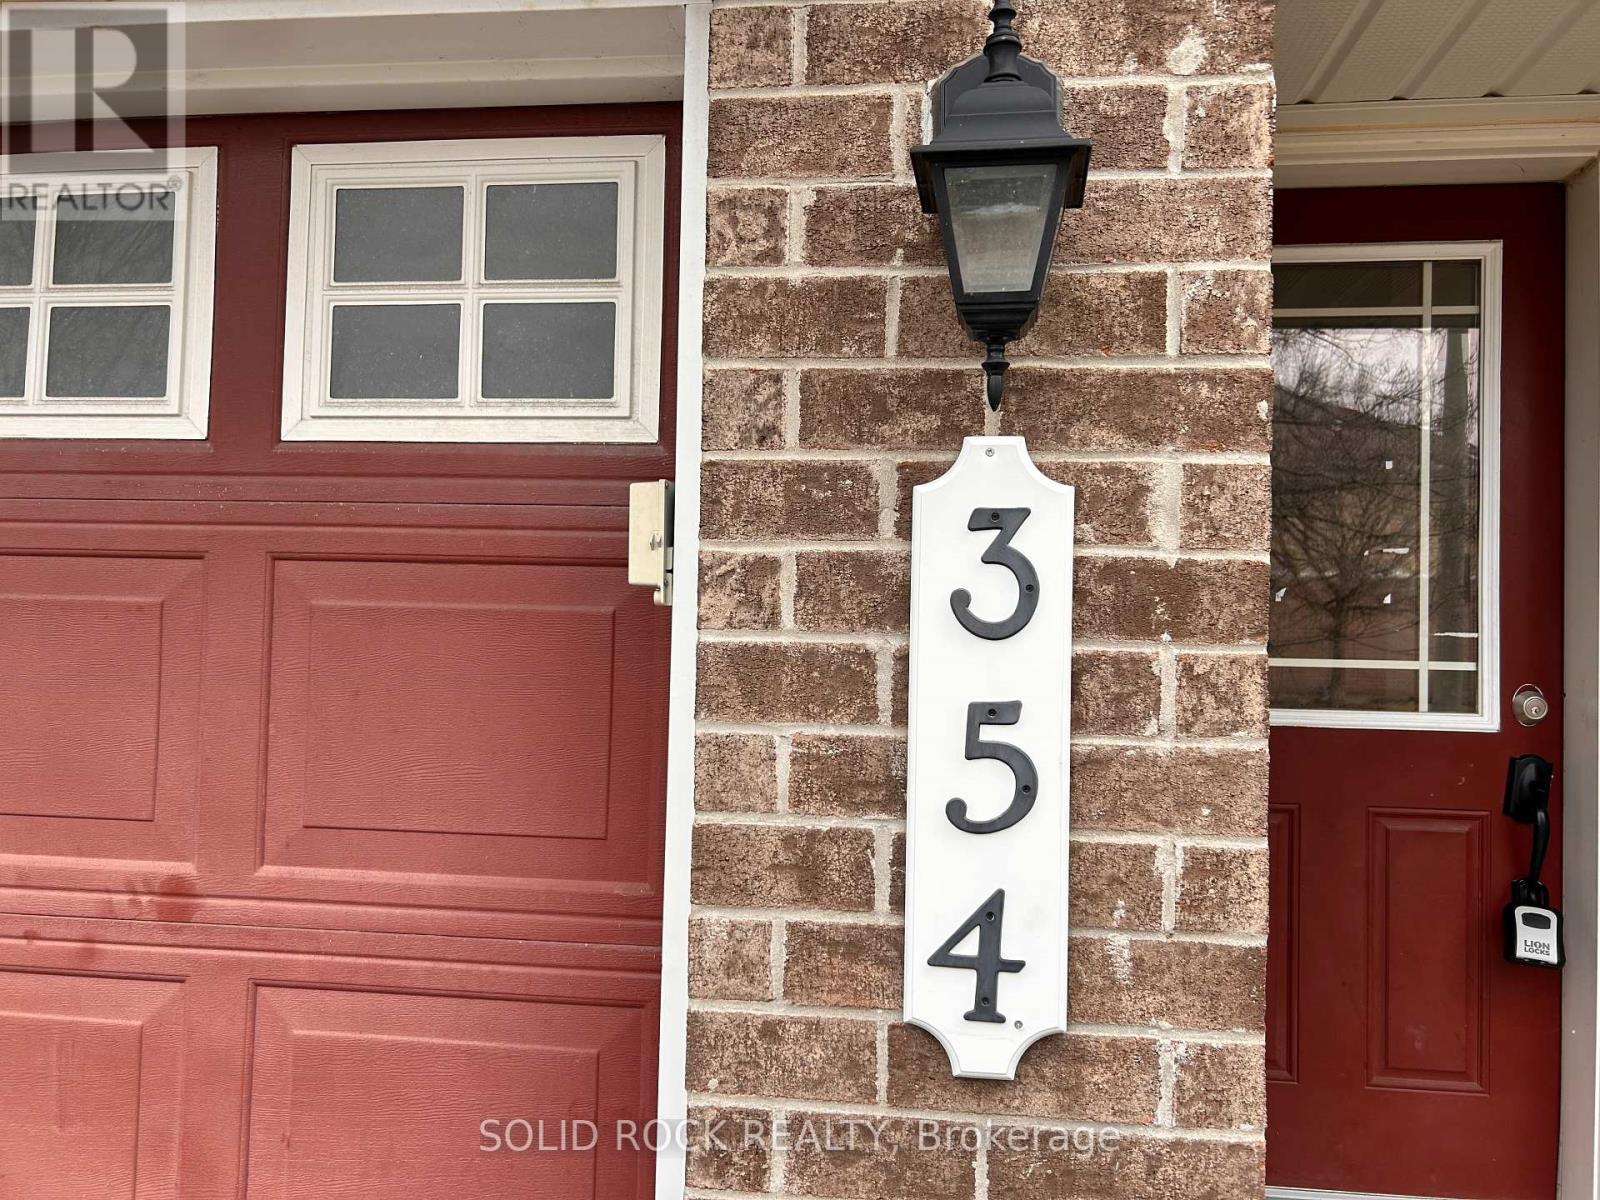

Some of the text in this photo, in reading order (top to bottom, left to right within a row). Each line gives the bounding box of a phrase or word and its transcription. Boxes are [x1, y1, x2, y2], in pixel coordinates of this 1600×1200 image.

[927, 507, 1040, 1023] 354
[1524, 940, 1550, 951] LION
[1524, 947, 1550, 956] LOCKS
